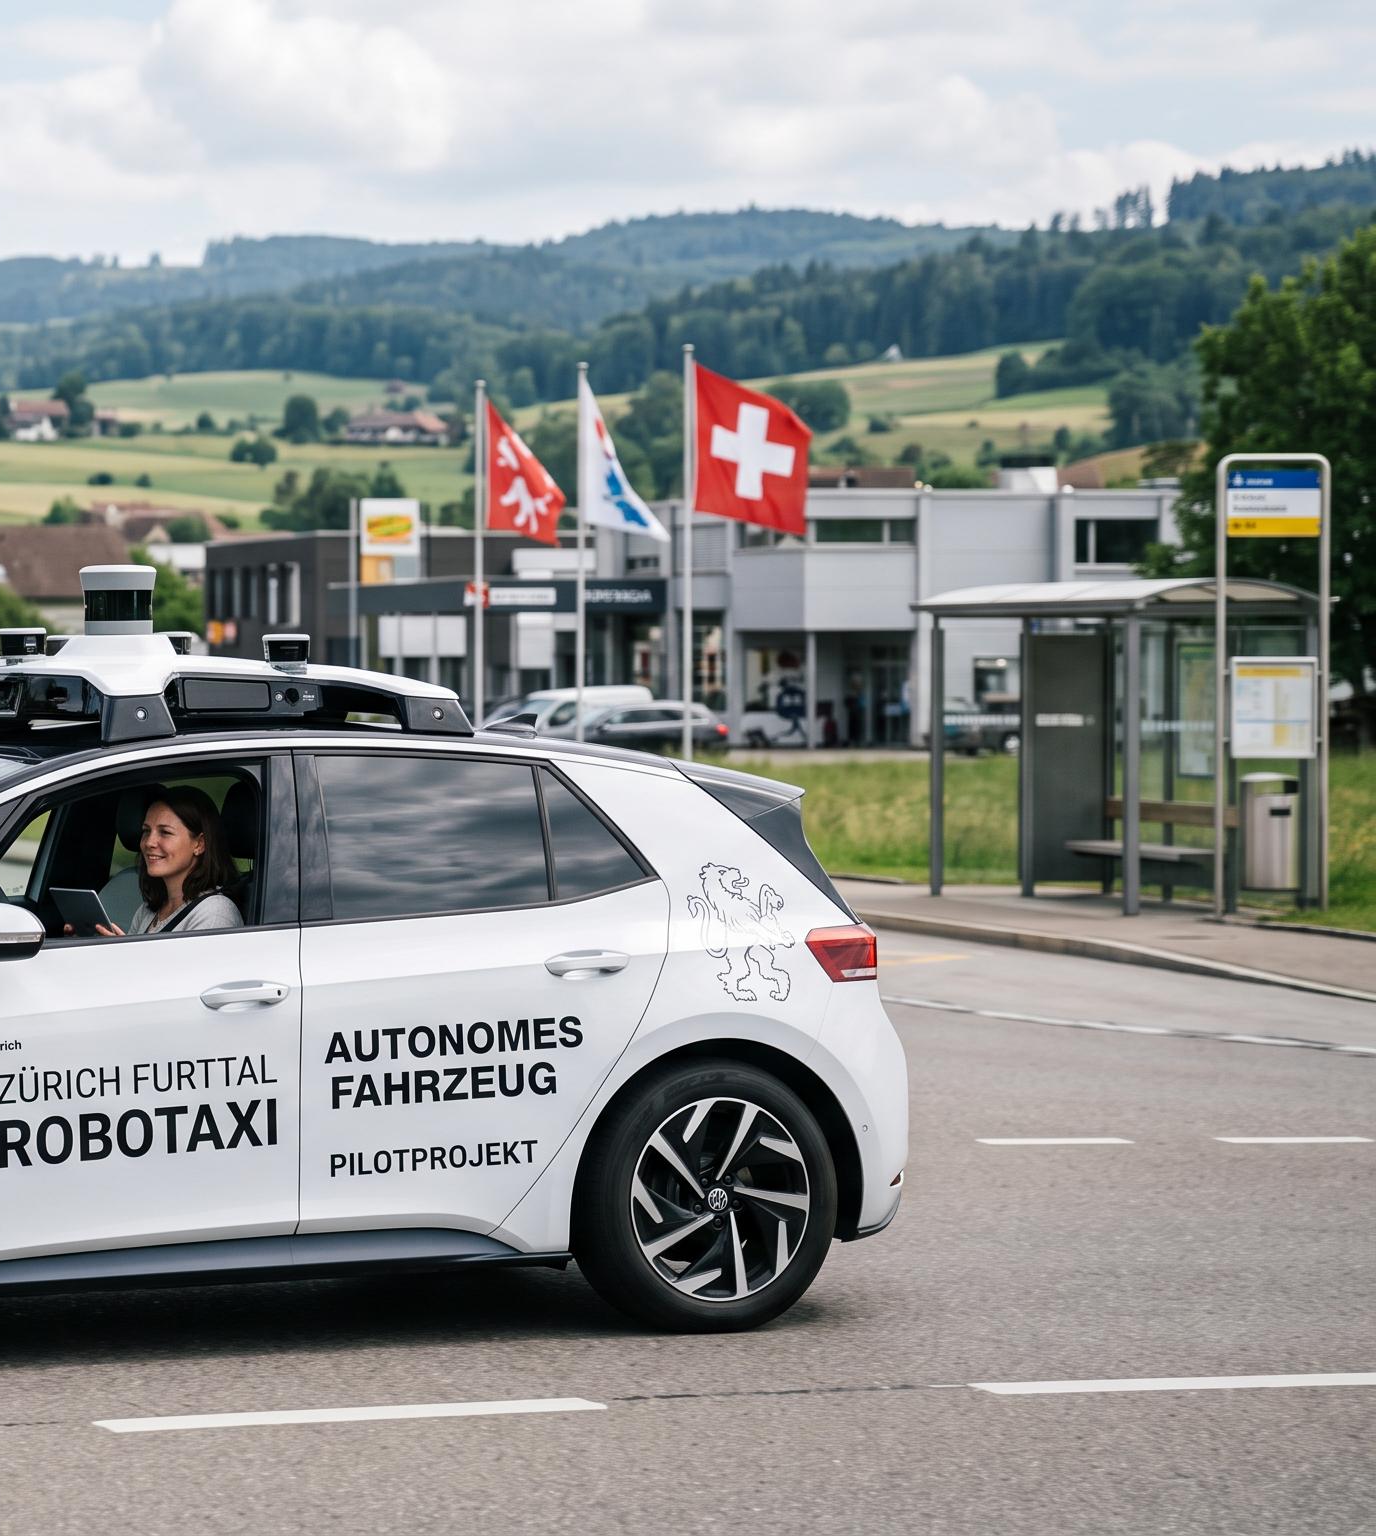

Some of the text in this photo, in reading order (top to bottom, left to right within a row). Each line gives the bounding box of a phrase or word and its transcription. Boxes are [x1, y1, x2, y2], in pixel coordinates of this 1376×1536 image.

[324, 1016, 584, 1064] AUTONOMES
[133, 1054, 278, 1095] FURTTAL
[331, 1062, 557, 1110] FAHRZEUG
[330, 1140, 538, 1178] PILOTPROJEKT
